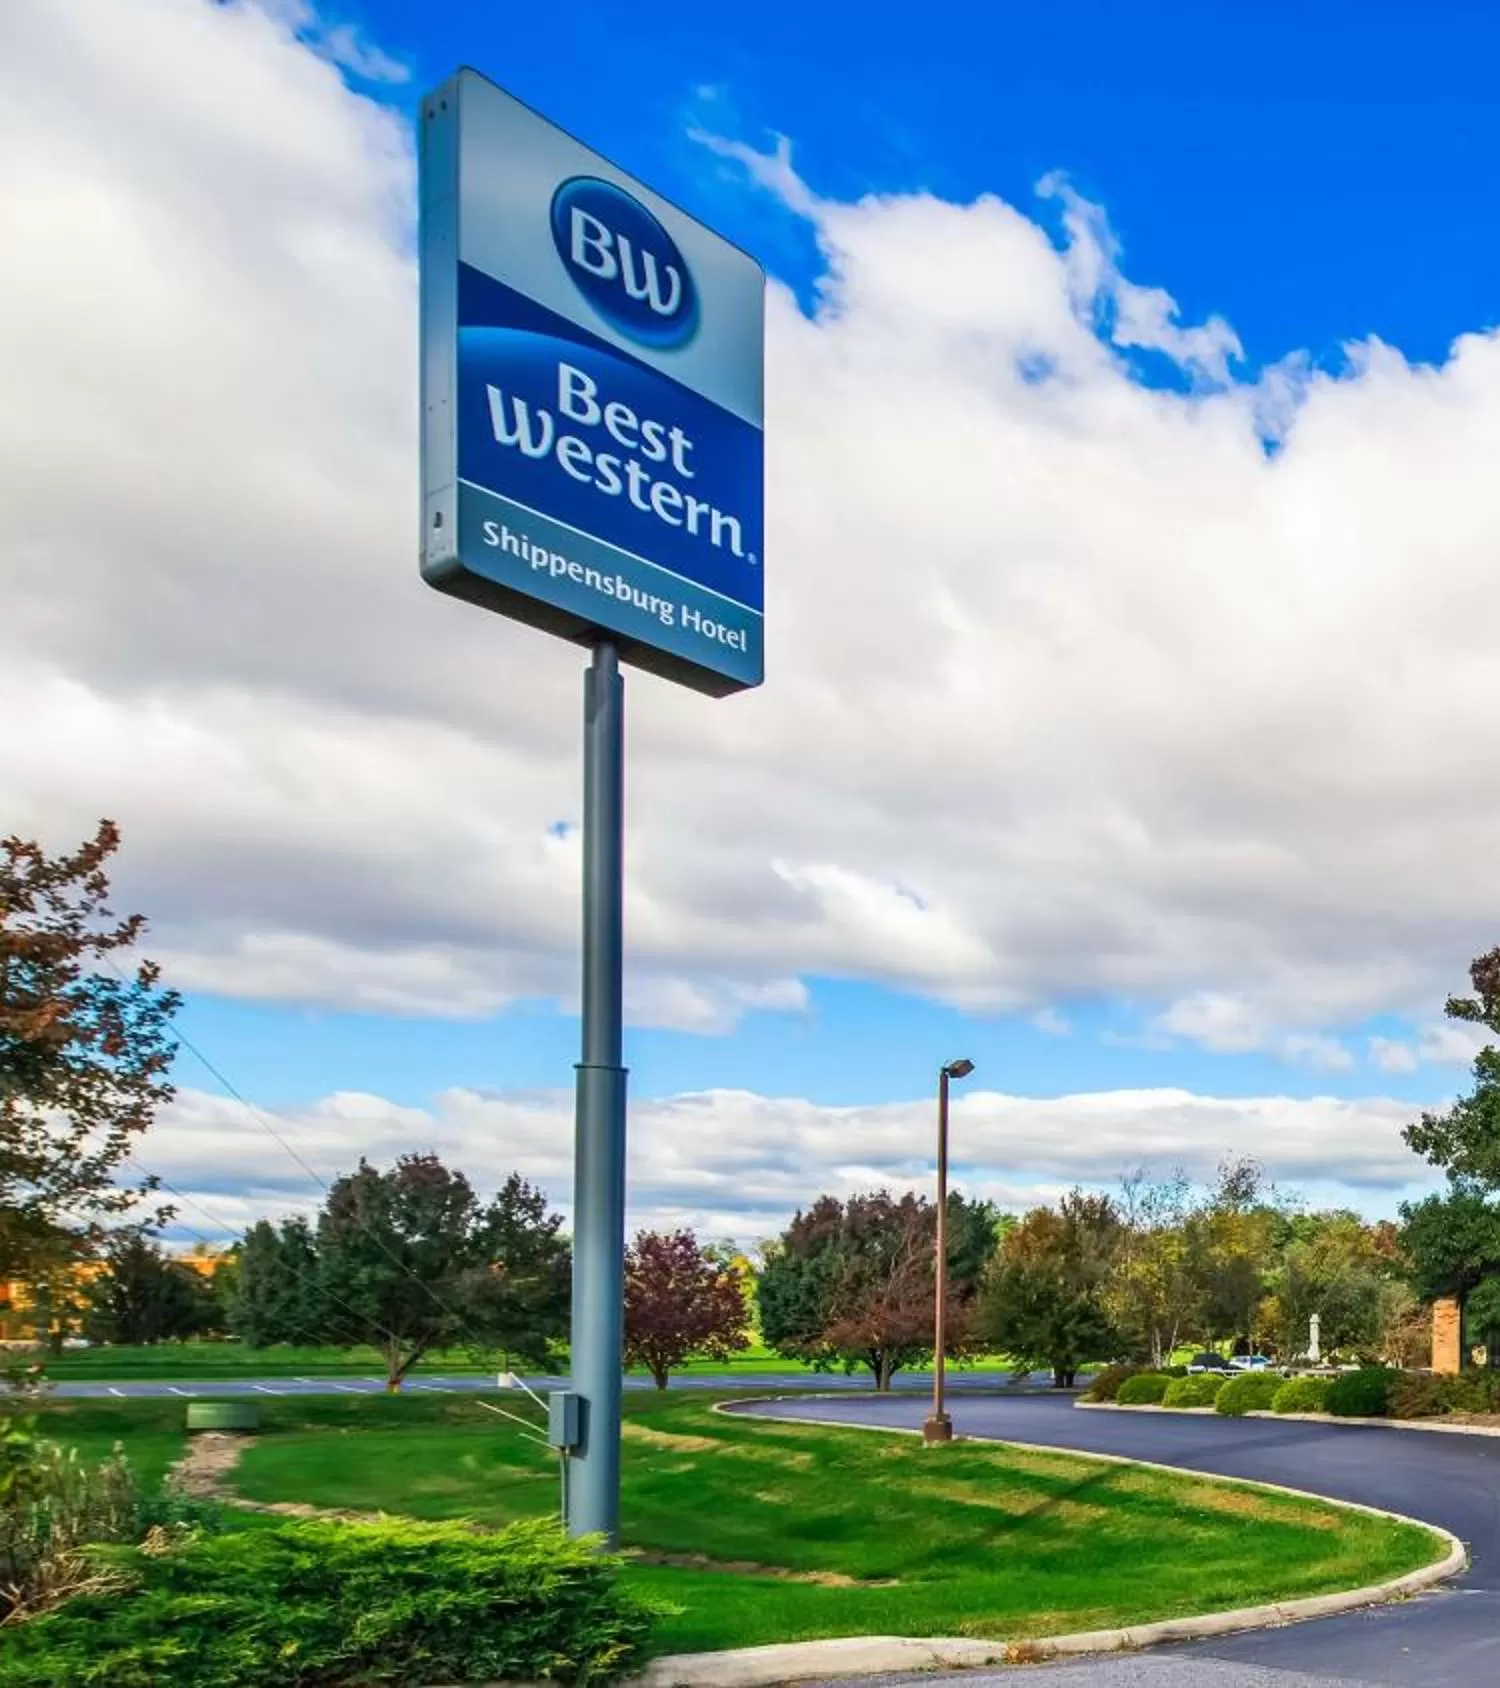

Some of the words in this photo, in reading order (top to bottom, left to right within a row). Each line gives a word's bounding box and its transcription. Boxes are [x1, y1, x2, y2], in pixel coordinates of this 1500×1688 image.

[571, 206, 681, 316] BW
[486, 384, 745, 557] Western
[558, 361, 695, 479] Best
[482, 520, 675, 626] Shippensburg
[681, 604, 747, 653] Hotel
